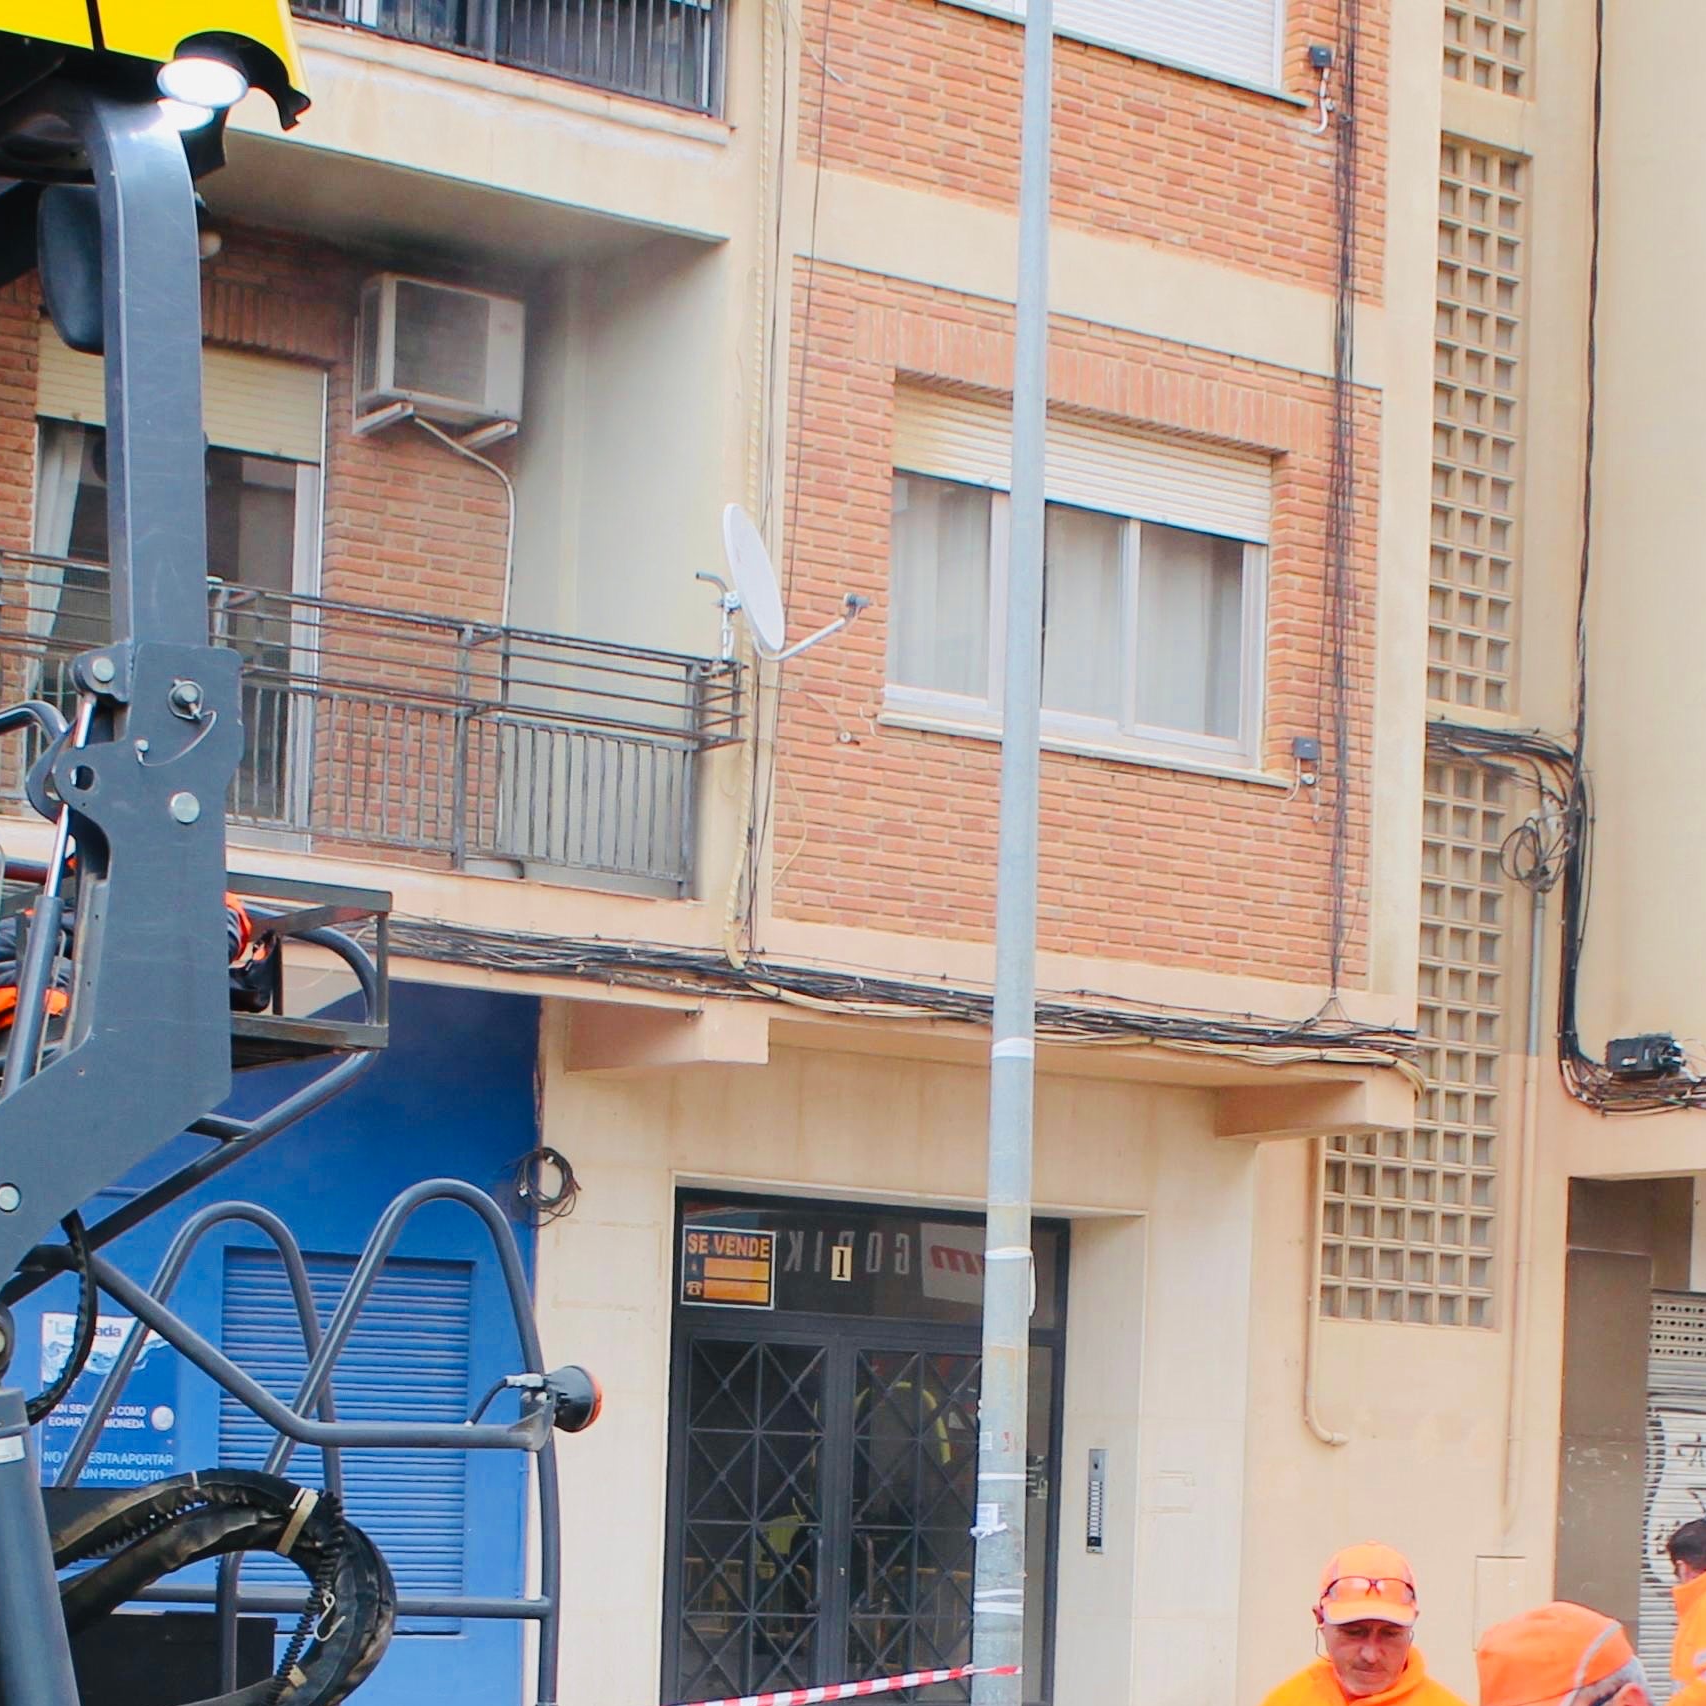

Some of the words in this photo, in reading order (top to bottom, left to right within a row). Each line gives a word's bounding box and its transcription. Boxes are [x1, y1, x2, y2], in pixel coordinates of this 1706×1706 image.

[687, 1235, 708, 1254] SE
[714, 1236, 770, 1258] VENDE
[117, 1406, 147, 1417] COMO
[48, 1416, 81, 1428] ECHAR
[44, 1451, 62, 1463] NO
[120, 1453, 174, 1466] APORTAR
[99, 1469, 165, 1481] PRODUCTO
